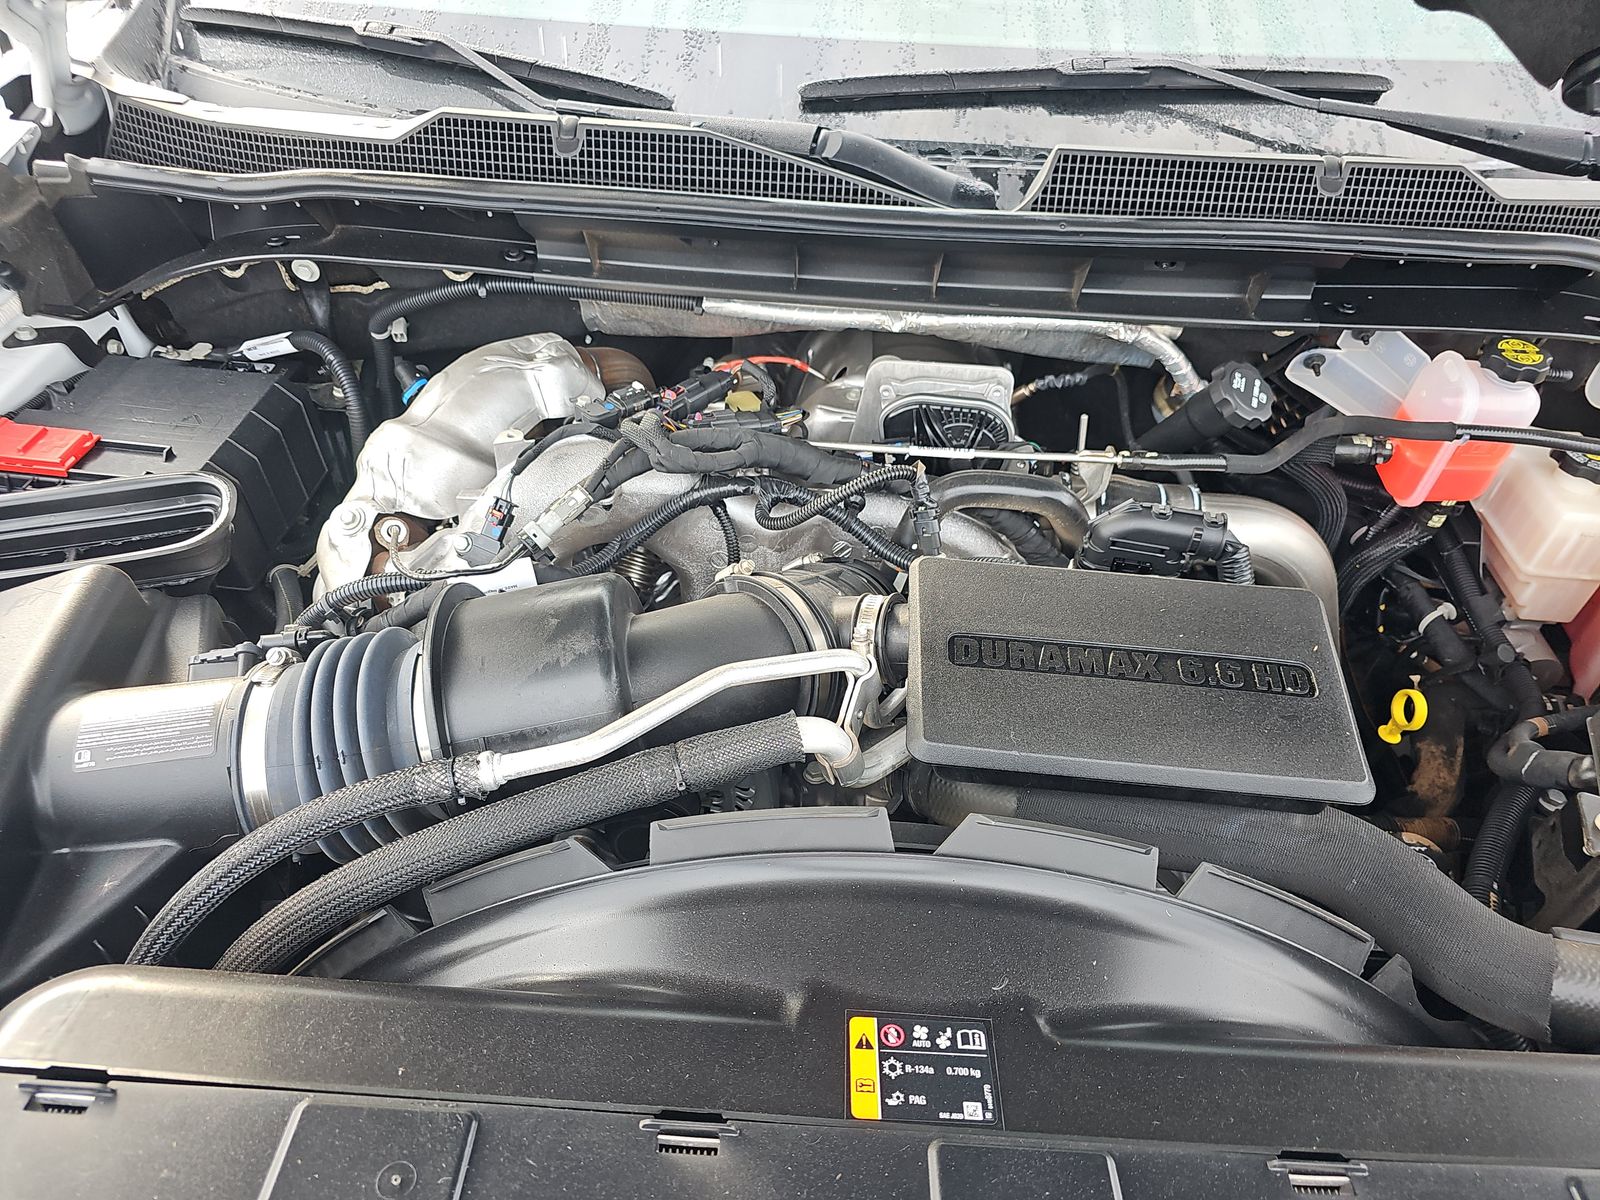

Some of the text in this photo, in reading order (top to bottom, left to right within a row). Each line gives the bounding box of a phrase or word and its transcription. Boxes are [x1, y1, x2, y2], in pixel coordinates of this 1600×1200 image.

[952, 636, 1311, 696] DURAMAX 6.6 HD
[912, 1040, 931, 1048] AUTO
[905, 1065, 981, 1078] R-134a 0.700 kg
[908, 1094, 927, 1105] PAG
